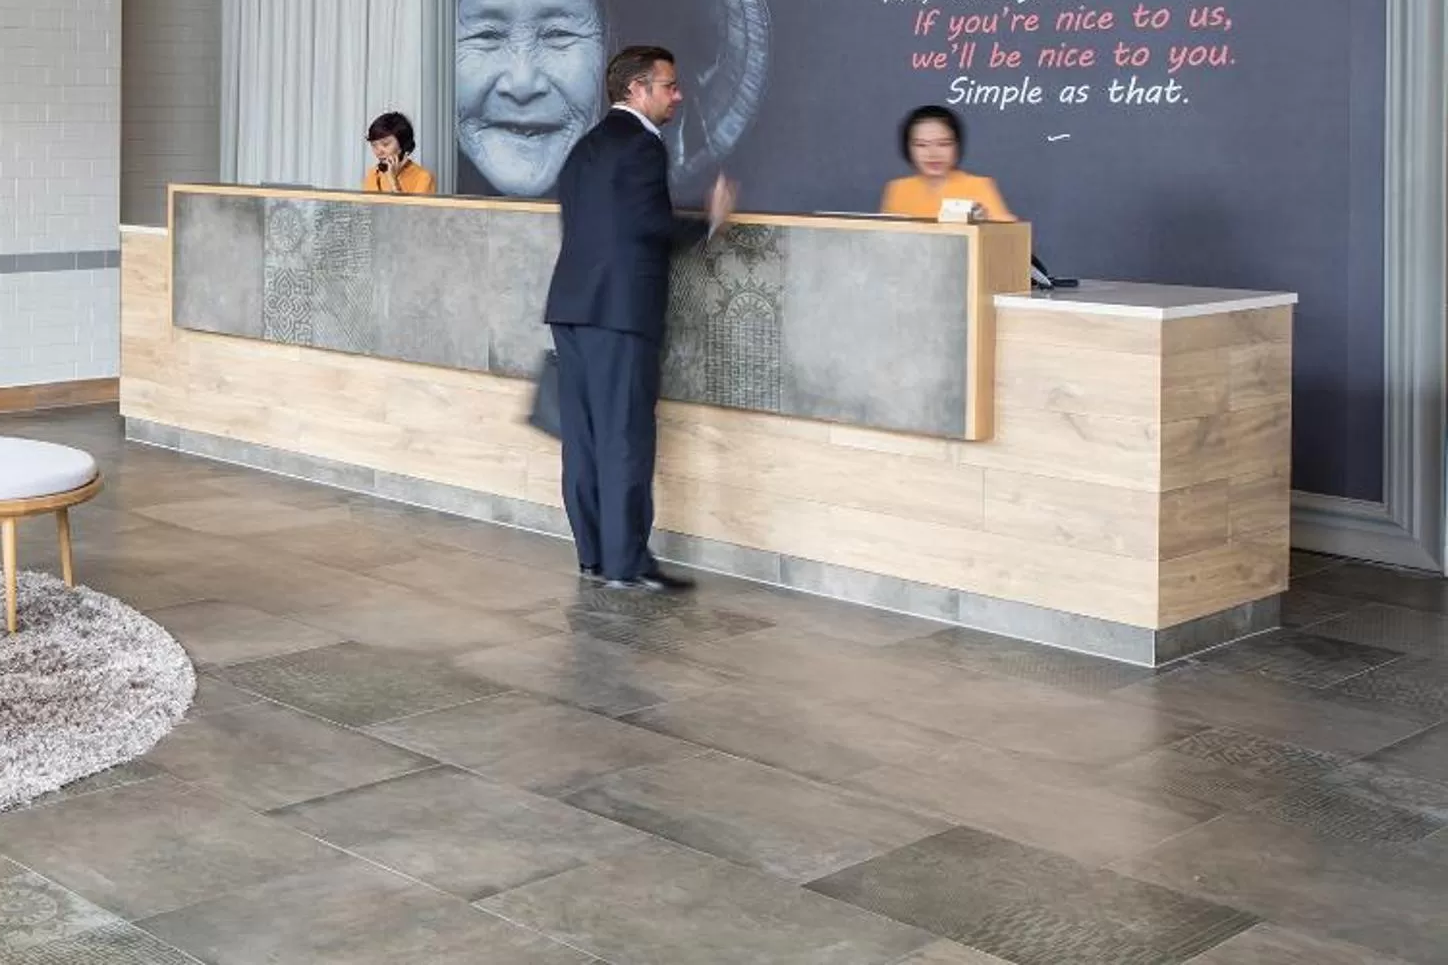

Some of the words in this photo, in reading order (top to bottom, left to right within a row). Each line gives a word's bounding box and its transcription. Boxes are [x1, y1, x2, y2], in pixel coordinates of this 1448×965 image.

[915, 9, 940, 35] If
[948, 7, 1039, 41] you're
[1056, 6, 1113, 31] nice
[1133, 4, 1170, 28] to
[1189, 7, 1232, 30] us,
[912, 42, 976, 69] we'll
[990, 42, 1021, 68] be
[1038, 43, 1095, 67] nice
[1114, 42, 1150, 66] to
[1168, 45, 1235, 73] you.
[946, 76, 1042, 110] Simple
[1059, 85, 1090, 104] as
[1108, 75, 1188, 104] that.
